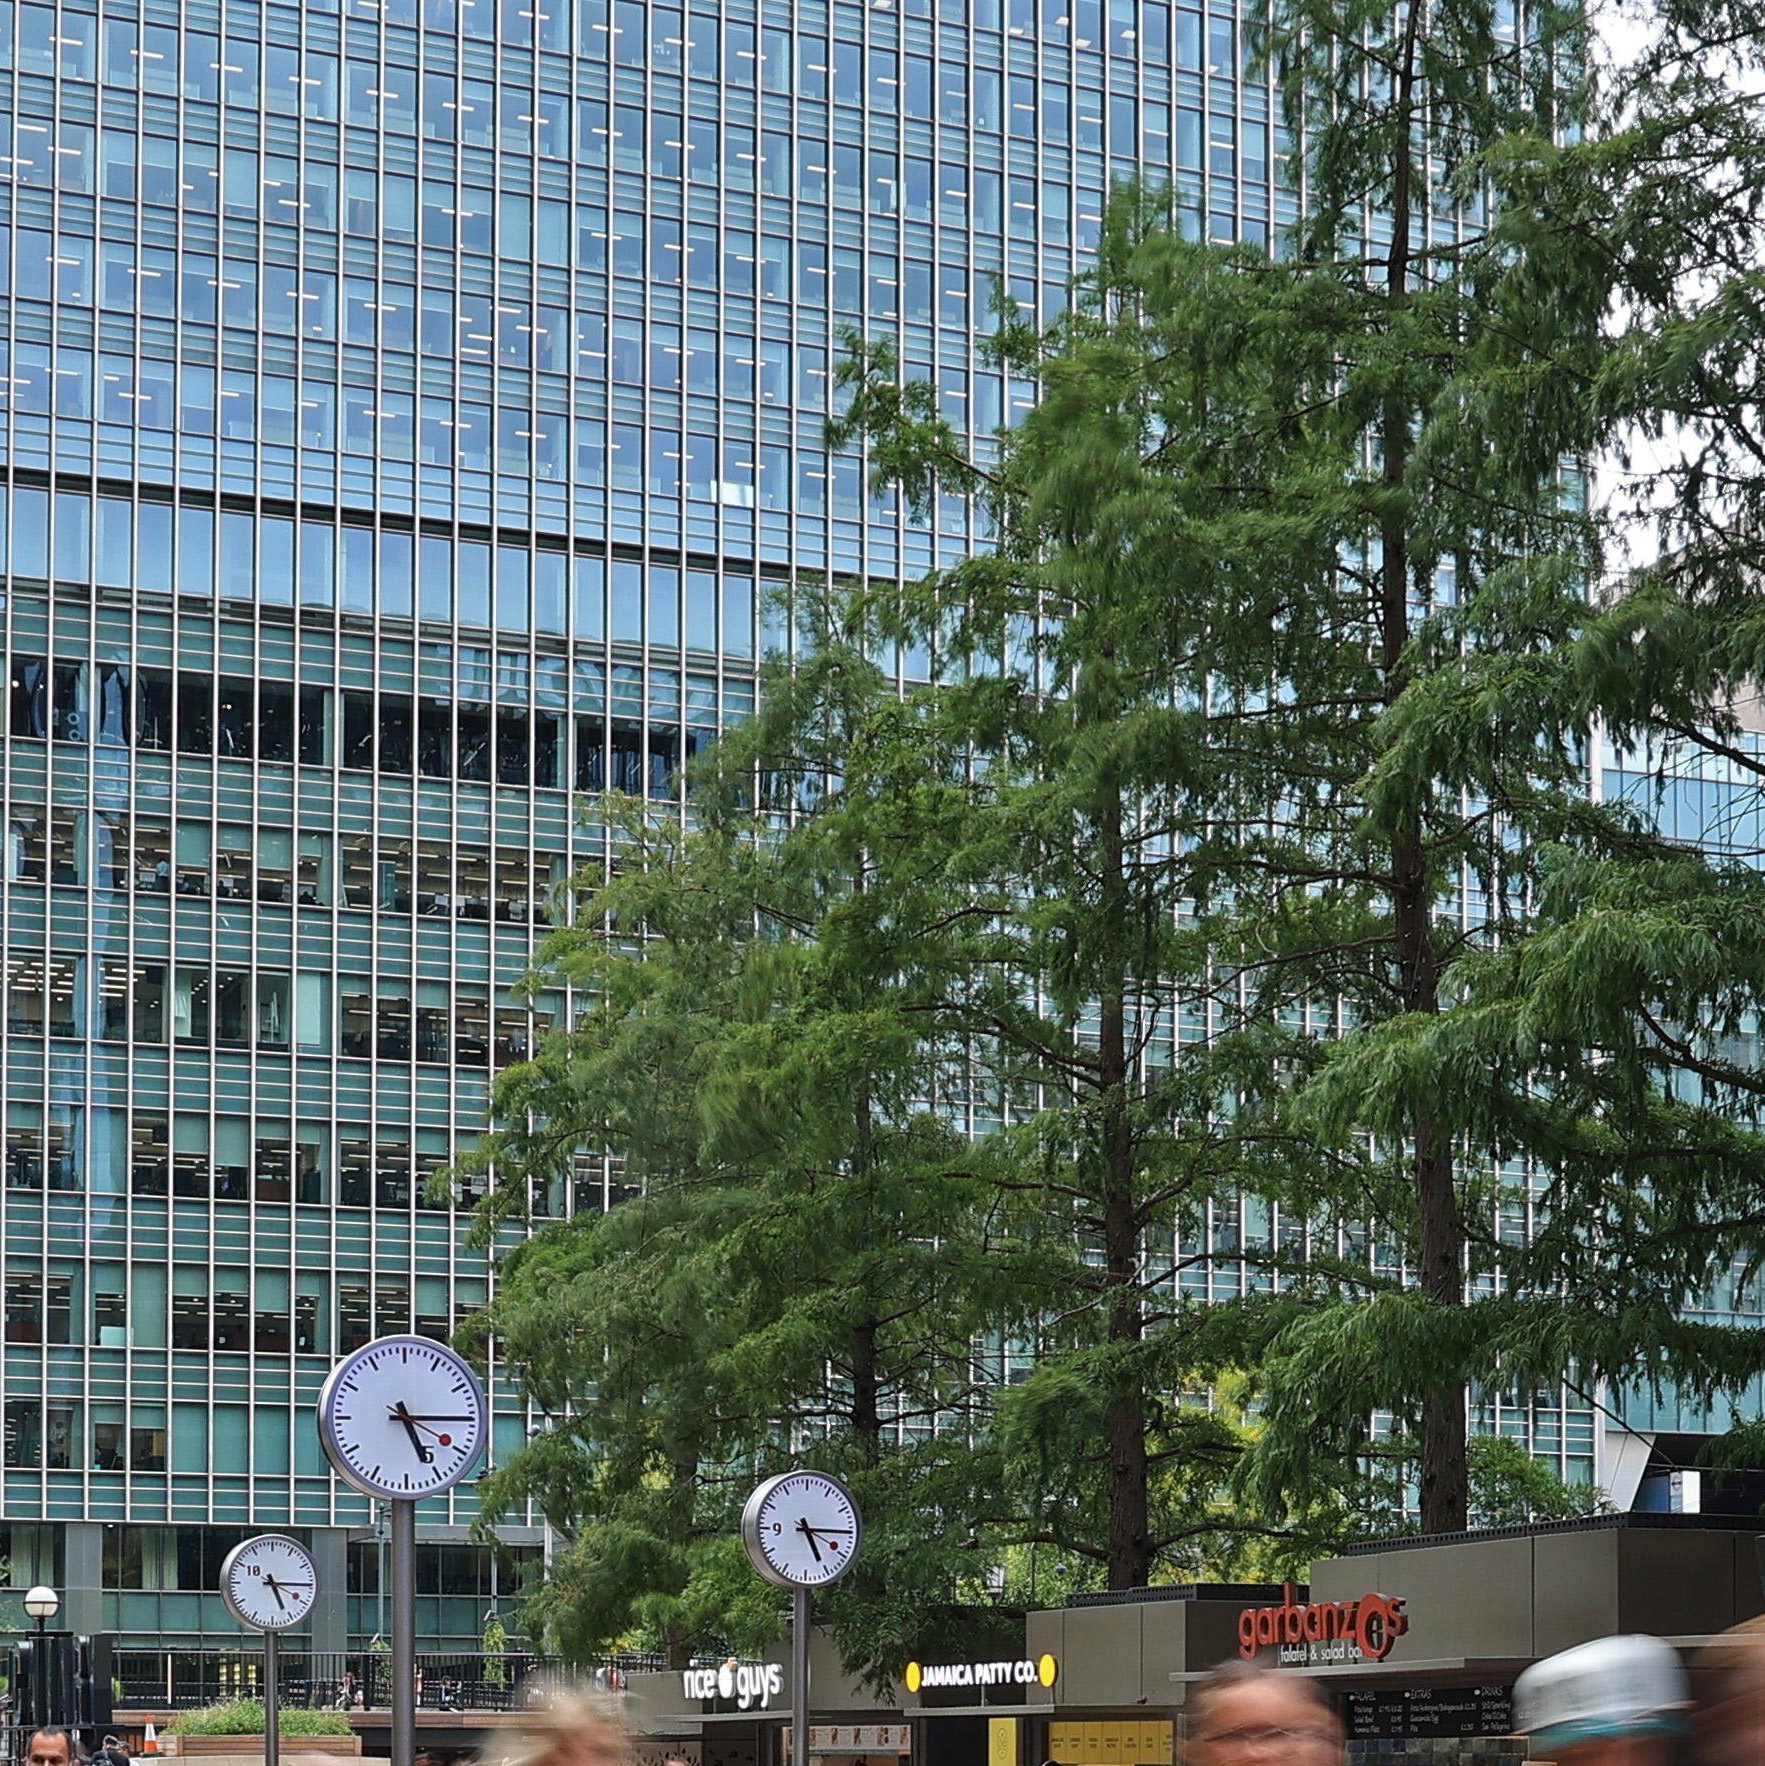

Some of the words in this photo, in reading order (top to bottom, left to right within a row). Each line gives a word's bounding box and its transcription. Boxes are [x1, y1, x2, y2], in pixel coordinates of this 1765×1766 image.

[421, 1445, 435, 1464] 5
[772, 1522, 782, 1537] 9
[246, 1564, 261, 1577] 10
[1280, 1643, 1307, 1663] falafel
[1310, 1644, 1318, 1660] &
[1321, 1641, 1345, 1660] salad
[921, 1664, 974, 1687] JAMAICA
[975, 1661, 1013, 1685] PATTY
[1014, 1660, 1038, 1683] CO.
[683, 1659, 715, 1699] rice
[736, 1663, 781, 1709] guys
